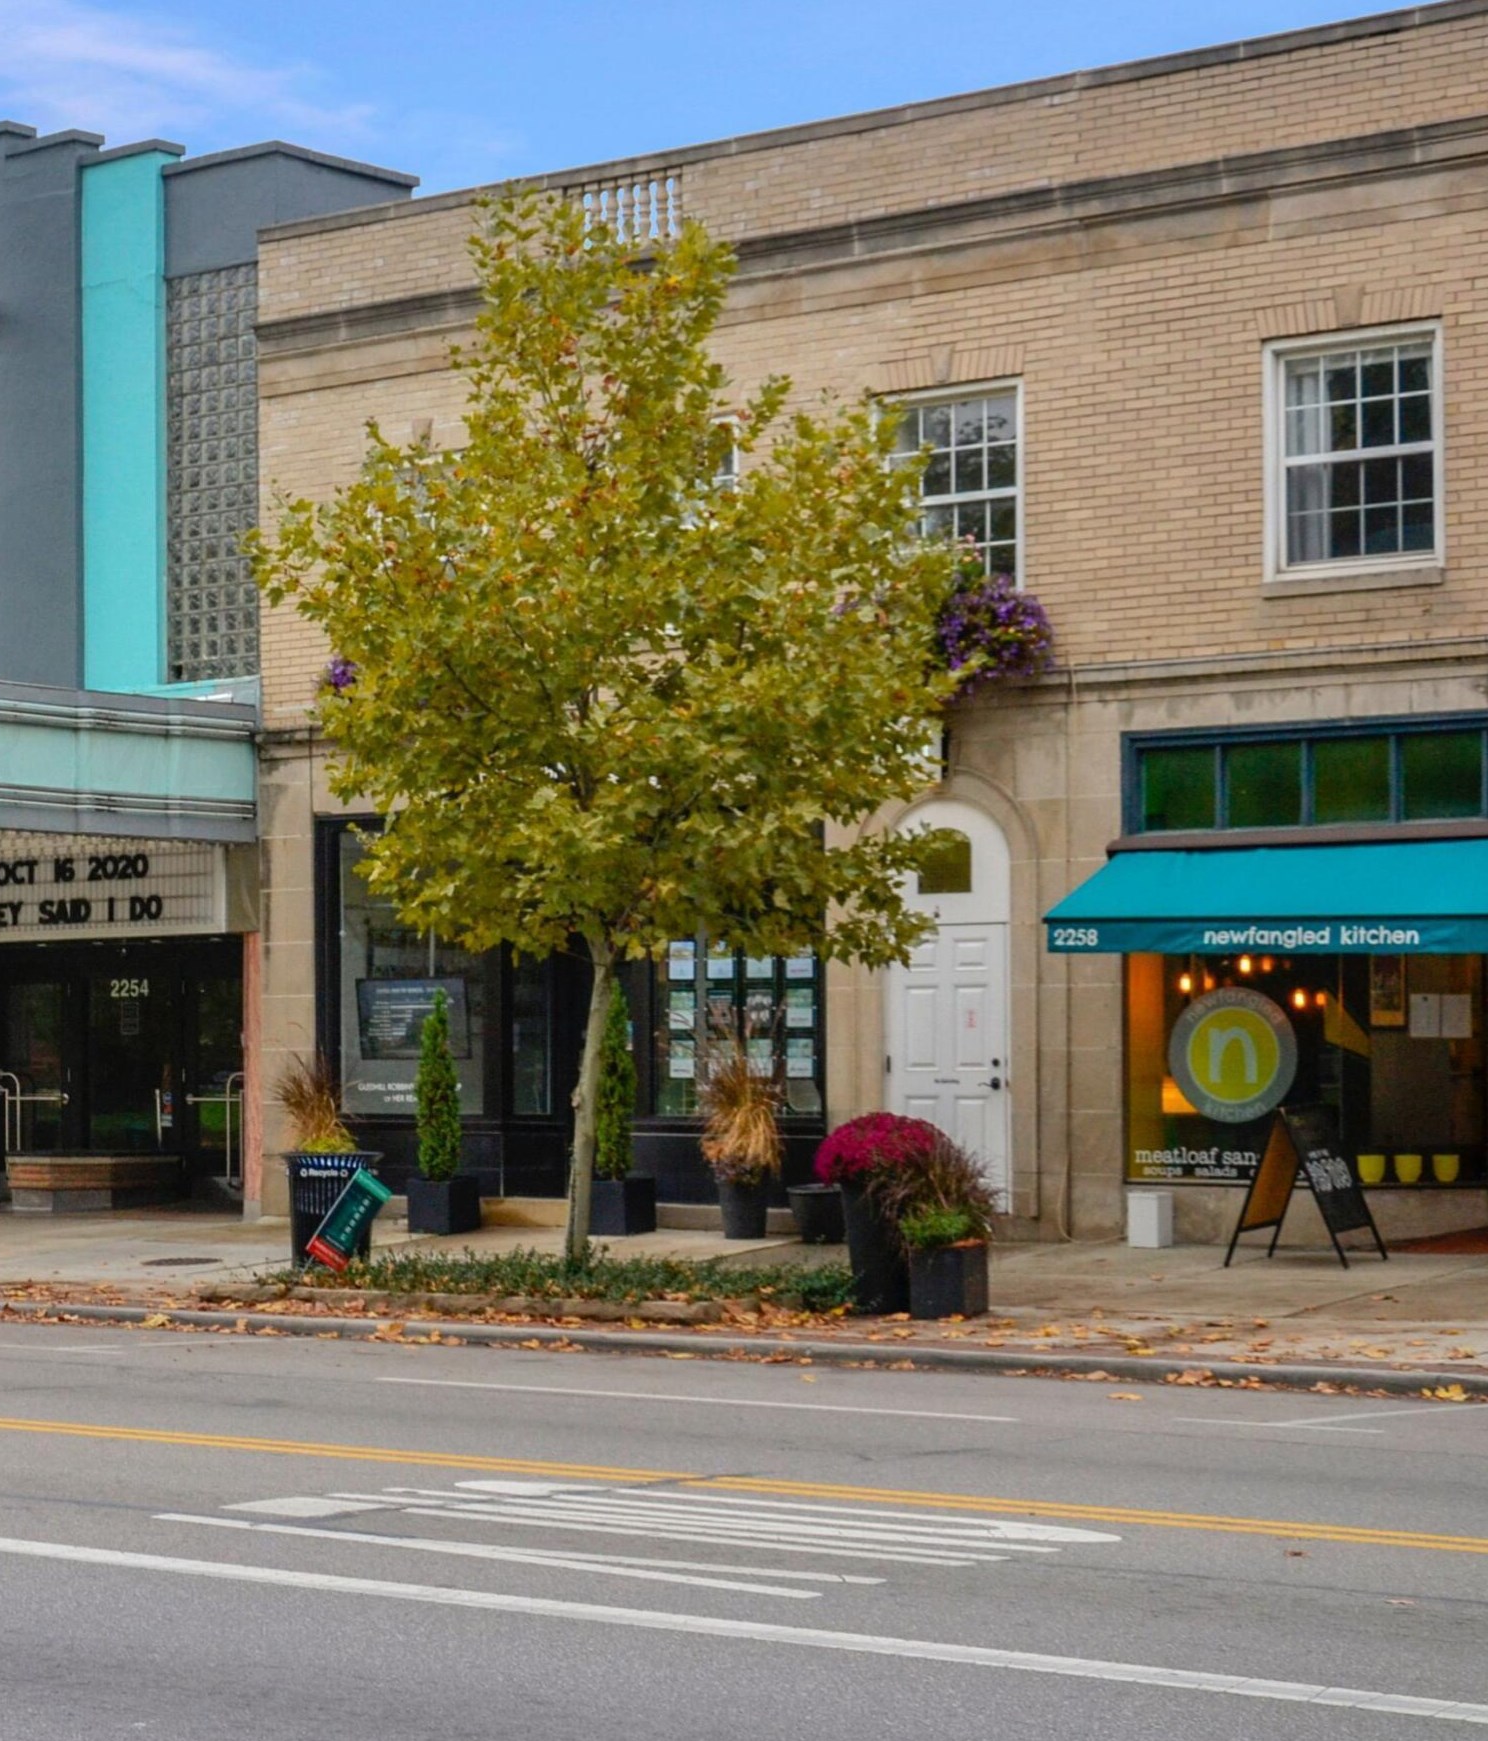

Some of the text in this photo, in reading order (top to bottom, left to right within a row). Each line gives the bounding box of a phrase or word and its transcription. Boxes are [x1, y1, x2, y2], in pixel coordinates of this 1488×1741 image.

[54, 857, 75, 883] 16
[87, 853, 149, 881] 2020
[38, 897, 91, 925] SAID
[107, 897, 115, 922] I
[129, 895, 163, 922] DO
[1053, 925, 1419, 949] 2258 newfangled kitchen
[110, 979, 149, 997] 2254
[1209, 1027, 1258, 1084] n
[1134, 1146, 1260, 1165] meatloaf san
[308, 1168, 338, 1178] Recycle
[1143, 1166, 1183, 1178] soups
[1194, 1165, 1238, 1177] salads
